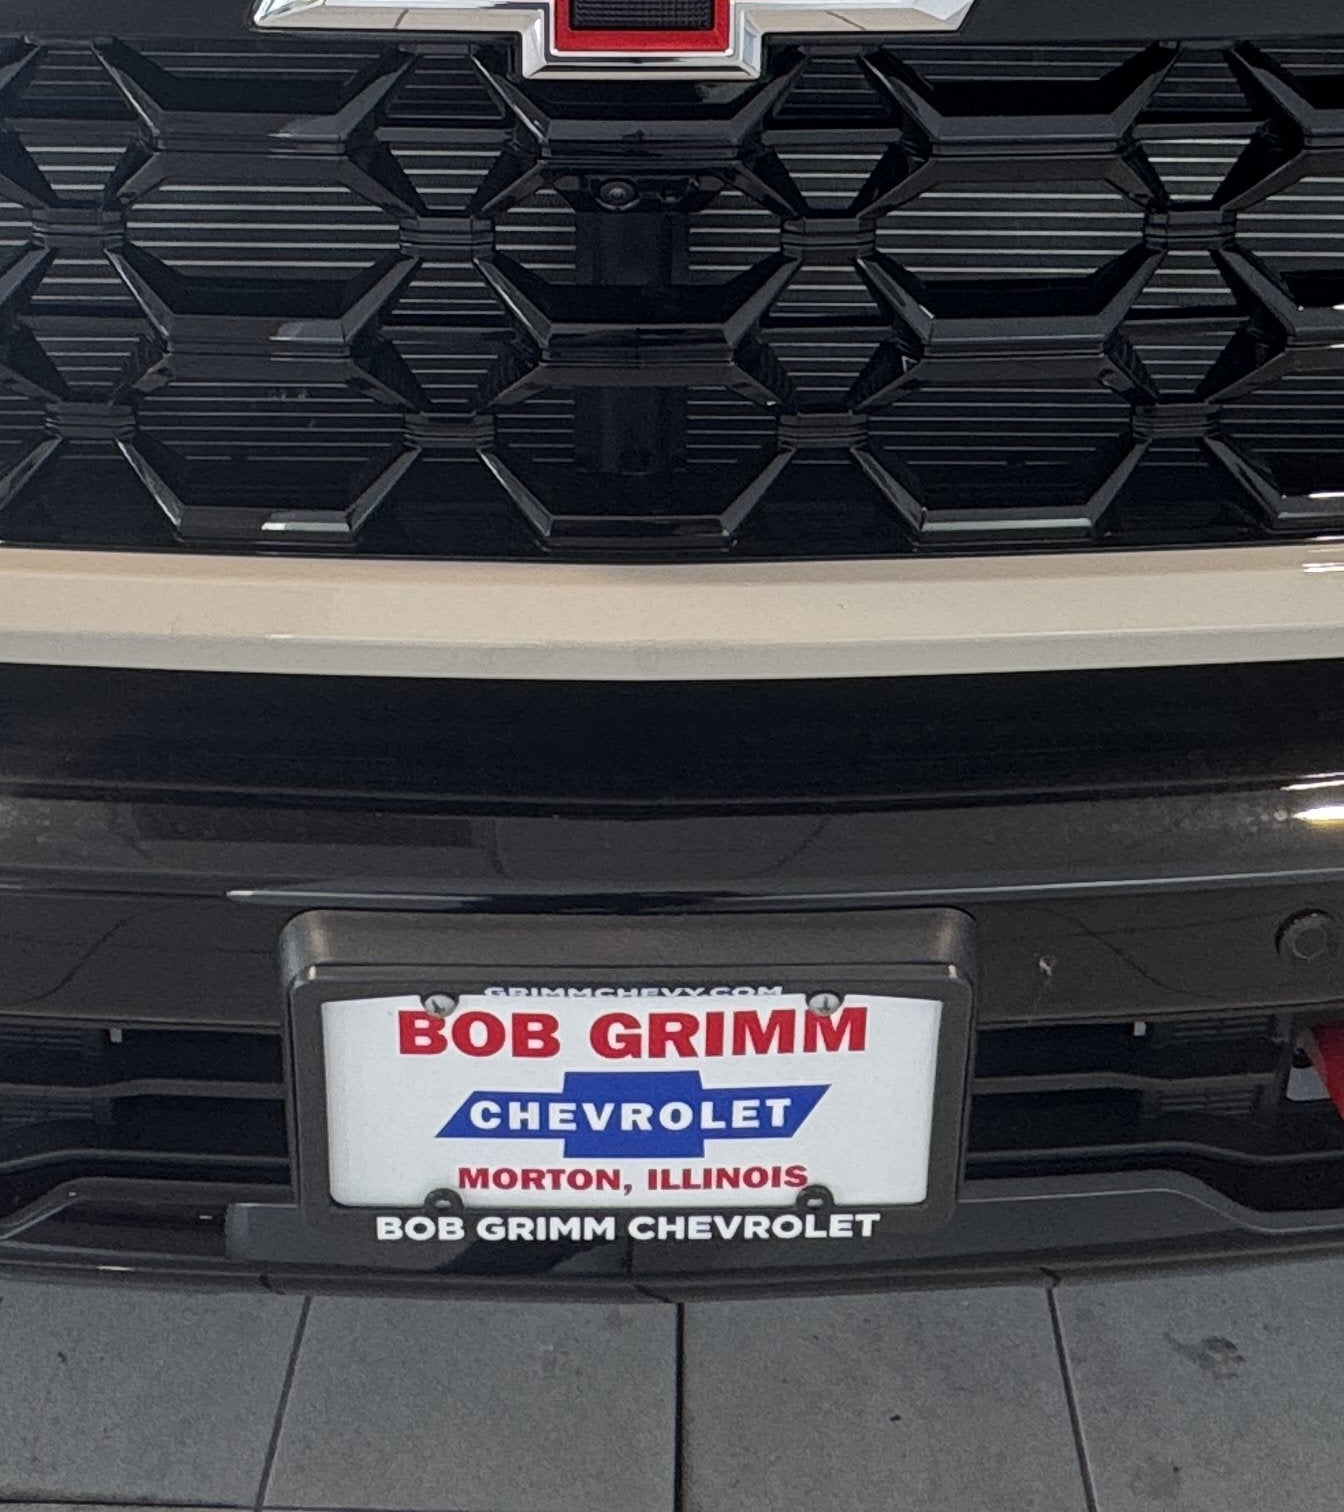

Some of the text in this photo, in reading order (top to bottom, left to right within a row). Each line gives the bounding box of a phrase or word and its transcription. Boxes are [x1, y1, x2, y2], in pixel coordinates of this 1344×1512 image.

[398, 1006, 868, 1059] BOB GRIMM
[469, 1098, 792, 1131] CHEVROLET
[458, 1165, 808, 1196] MORTON, ILLINOIS
[376, 1213, 882, 1241] BOB GRIMM CHEVROLET
